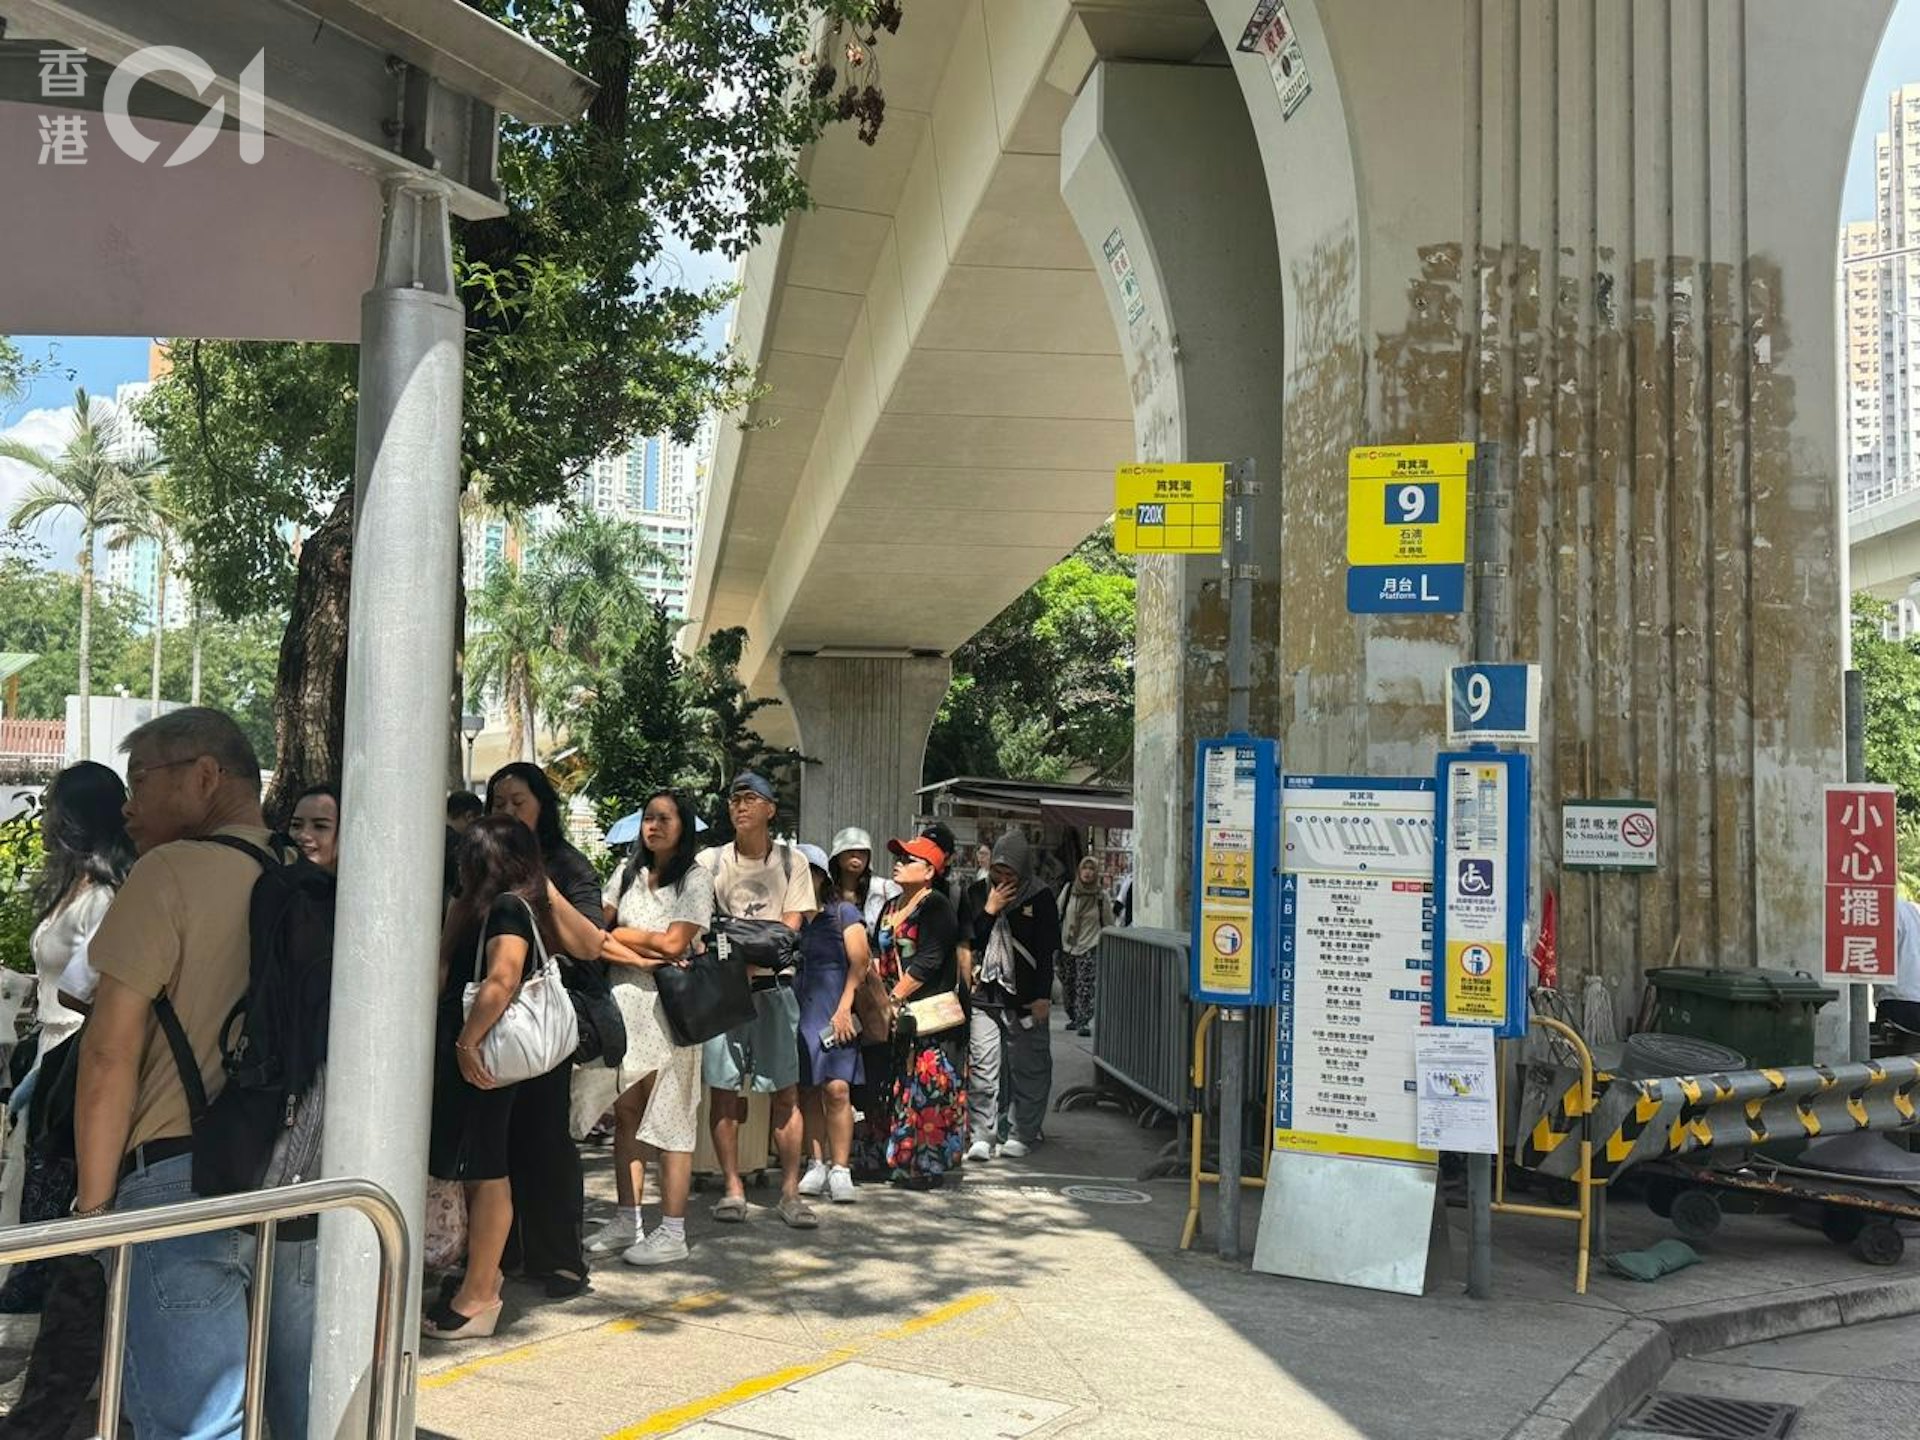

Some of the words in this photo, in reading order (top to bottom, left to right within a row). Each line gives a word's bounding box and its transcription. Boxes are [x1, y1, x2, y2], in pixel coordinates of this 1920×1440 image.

[1399, 485, 1425, 522] 9
[1137, 504, 1164, 523] 720X
[1383, 577, 1413, 592] 月台
[1421, 574, 1440, 601] L
[1379, 592, 1417, 600] Platform
[1468, 672, 1491, 723] 9
[1565, 817, 1618, 829] 嚴禁吸煙
[1565, 831, 1579, 839] No
[1580, 831, 1618, 842] Smoking
[1283, 880, 1294, 890] A
[1840, 795, 1883, 973] 小心擺尾
[1284, 904, 1293, 914] B
[1283, 940, 1292, 952] C
[1281, 969, 1291, 979] D
[1282, 989, 1290, 1001] E
[1281, 1012, 1290, 1024] F
[1280, 1030, 1290, 1042] H
[1281, 1072, 1288, 1083] J
[1280, 1090, 1289, 1101] K
[1280, 1110, 1288, 1121] L
